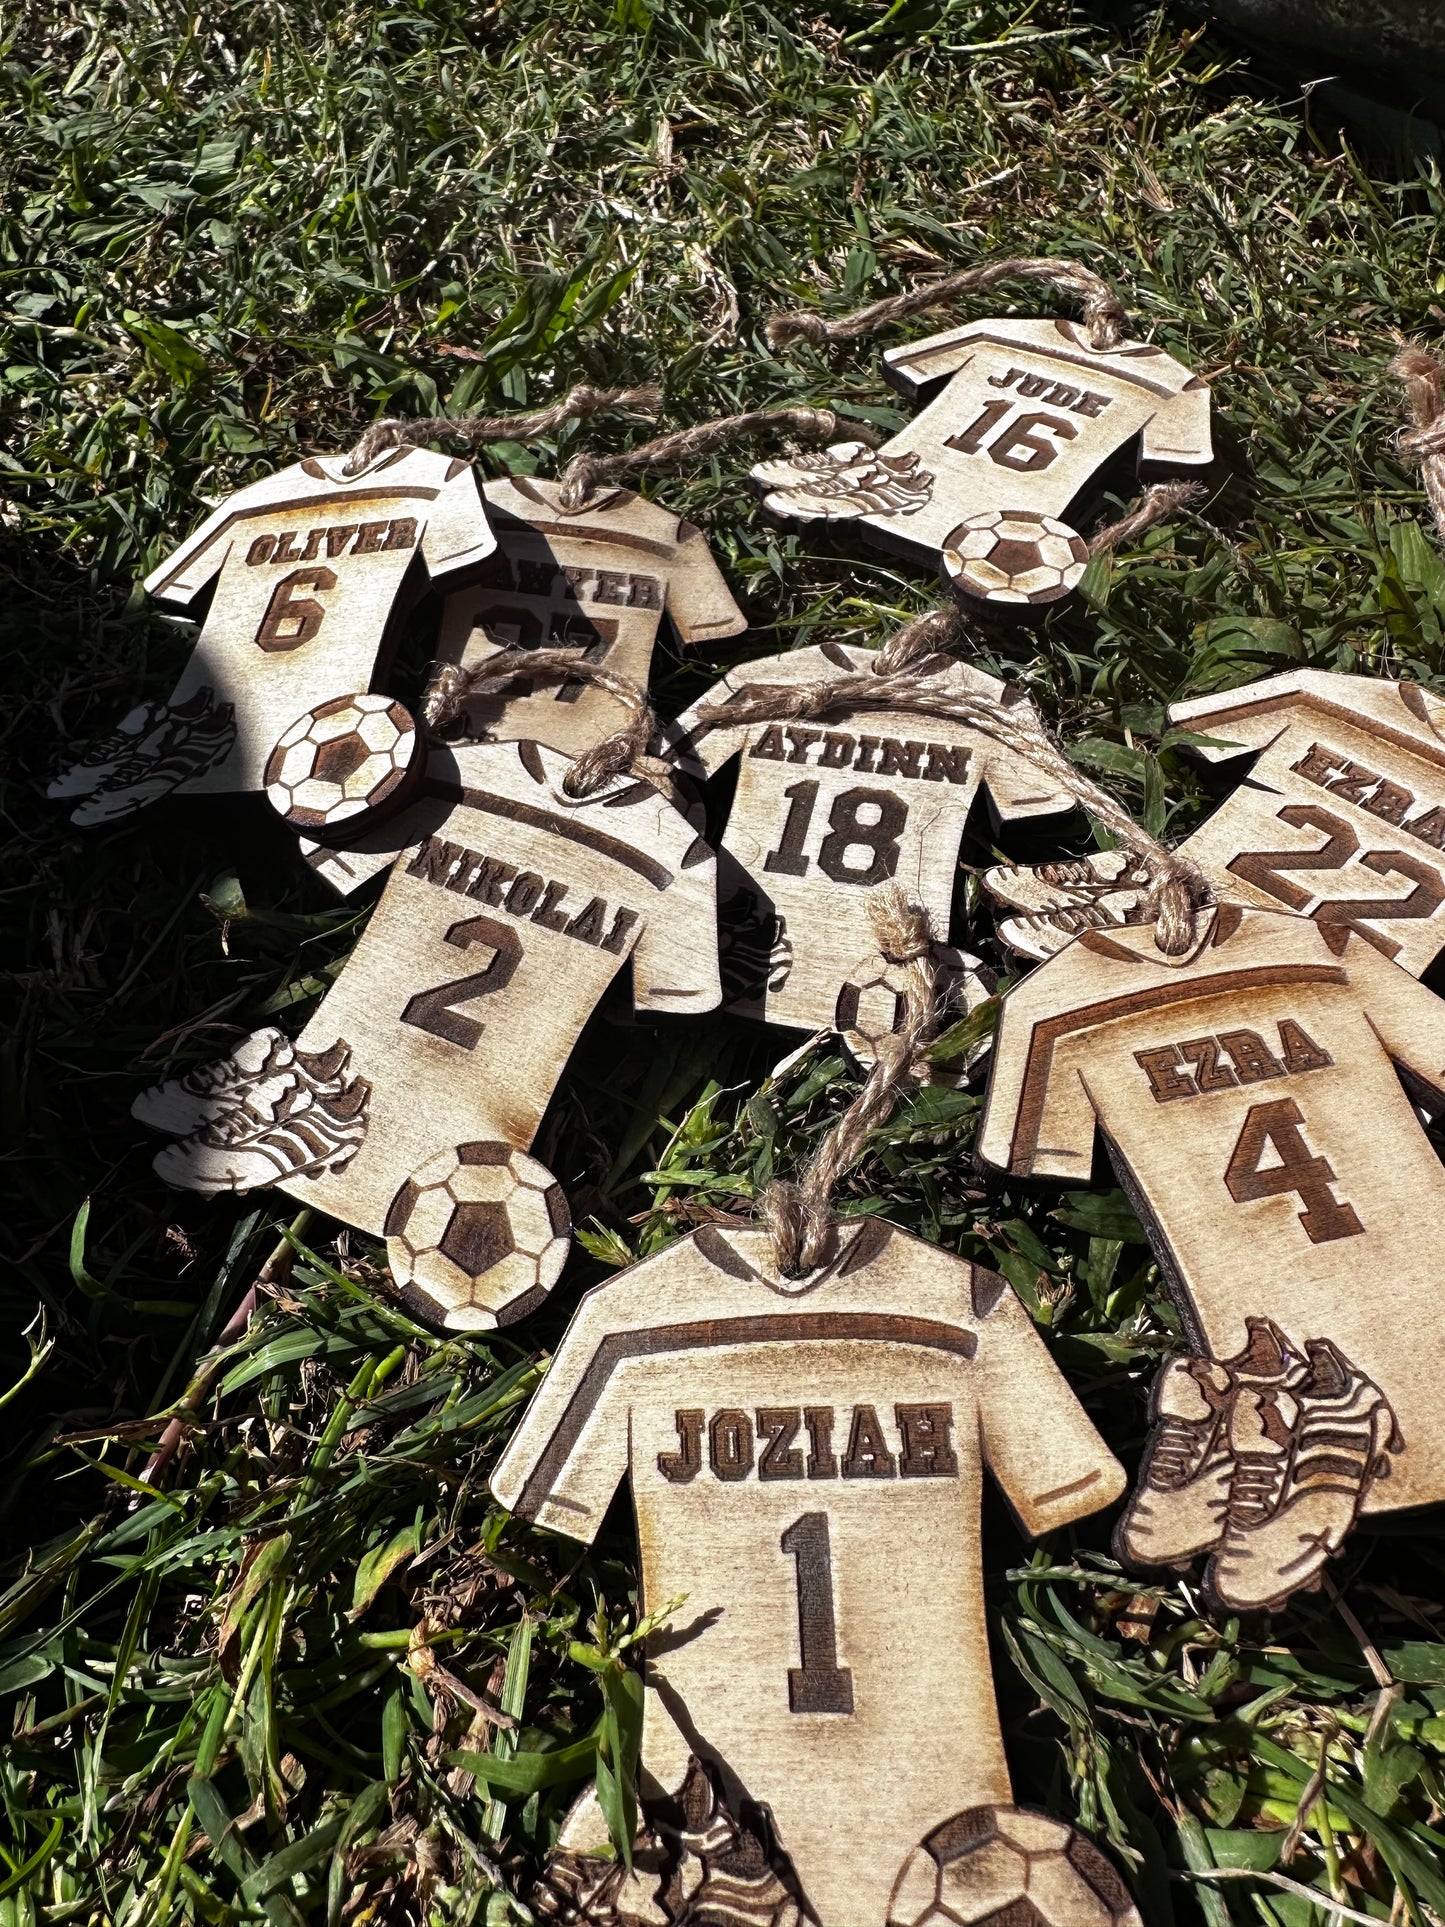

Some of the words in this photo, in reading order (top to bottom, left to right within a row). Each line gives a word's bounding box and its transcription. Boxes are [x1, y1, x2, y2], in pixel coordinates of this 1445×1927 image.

[943, 399, 1079, 472] 16
[987, 367, 1113, 418] JUDE
[245, 517, 419, 566] OLIVER
[254, 566, 338, 652] 6
[748, 724, 973, 785] AYDINN
[1289, 742, 1445, 850] EZRA
[763, 779, 909, 886] 18
[405, 836, 639, 955] NIKOLAI
[1225, 805, 1445, 960] 22
[400, 915, 525, 1051] 2
[1132, 1018, 1335, 1103] EZRA
[1223, 1096, 1366, 1244] 4
[657, 1401, 959, 1482] JOZIAH
[780, 1511, 855, 1714] 1
